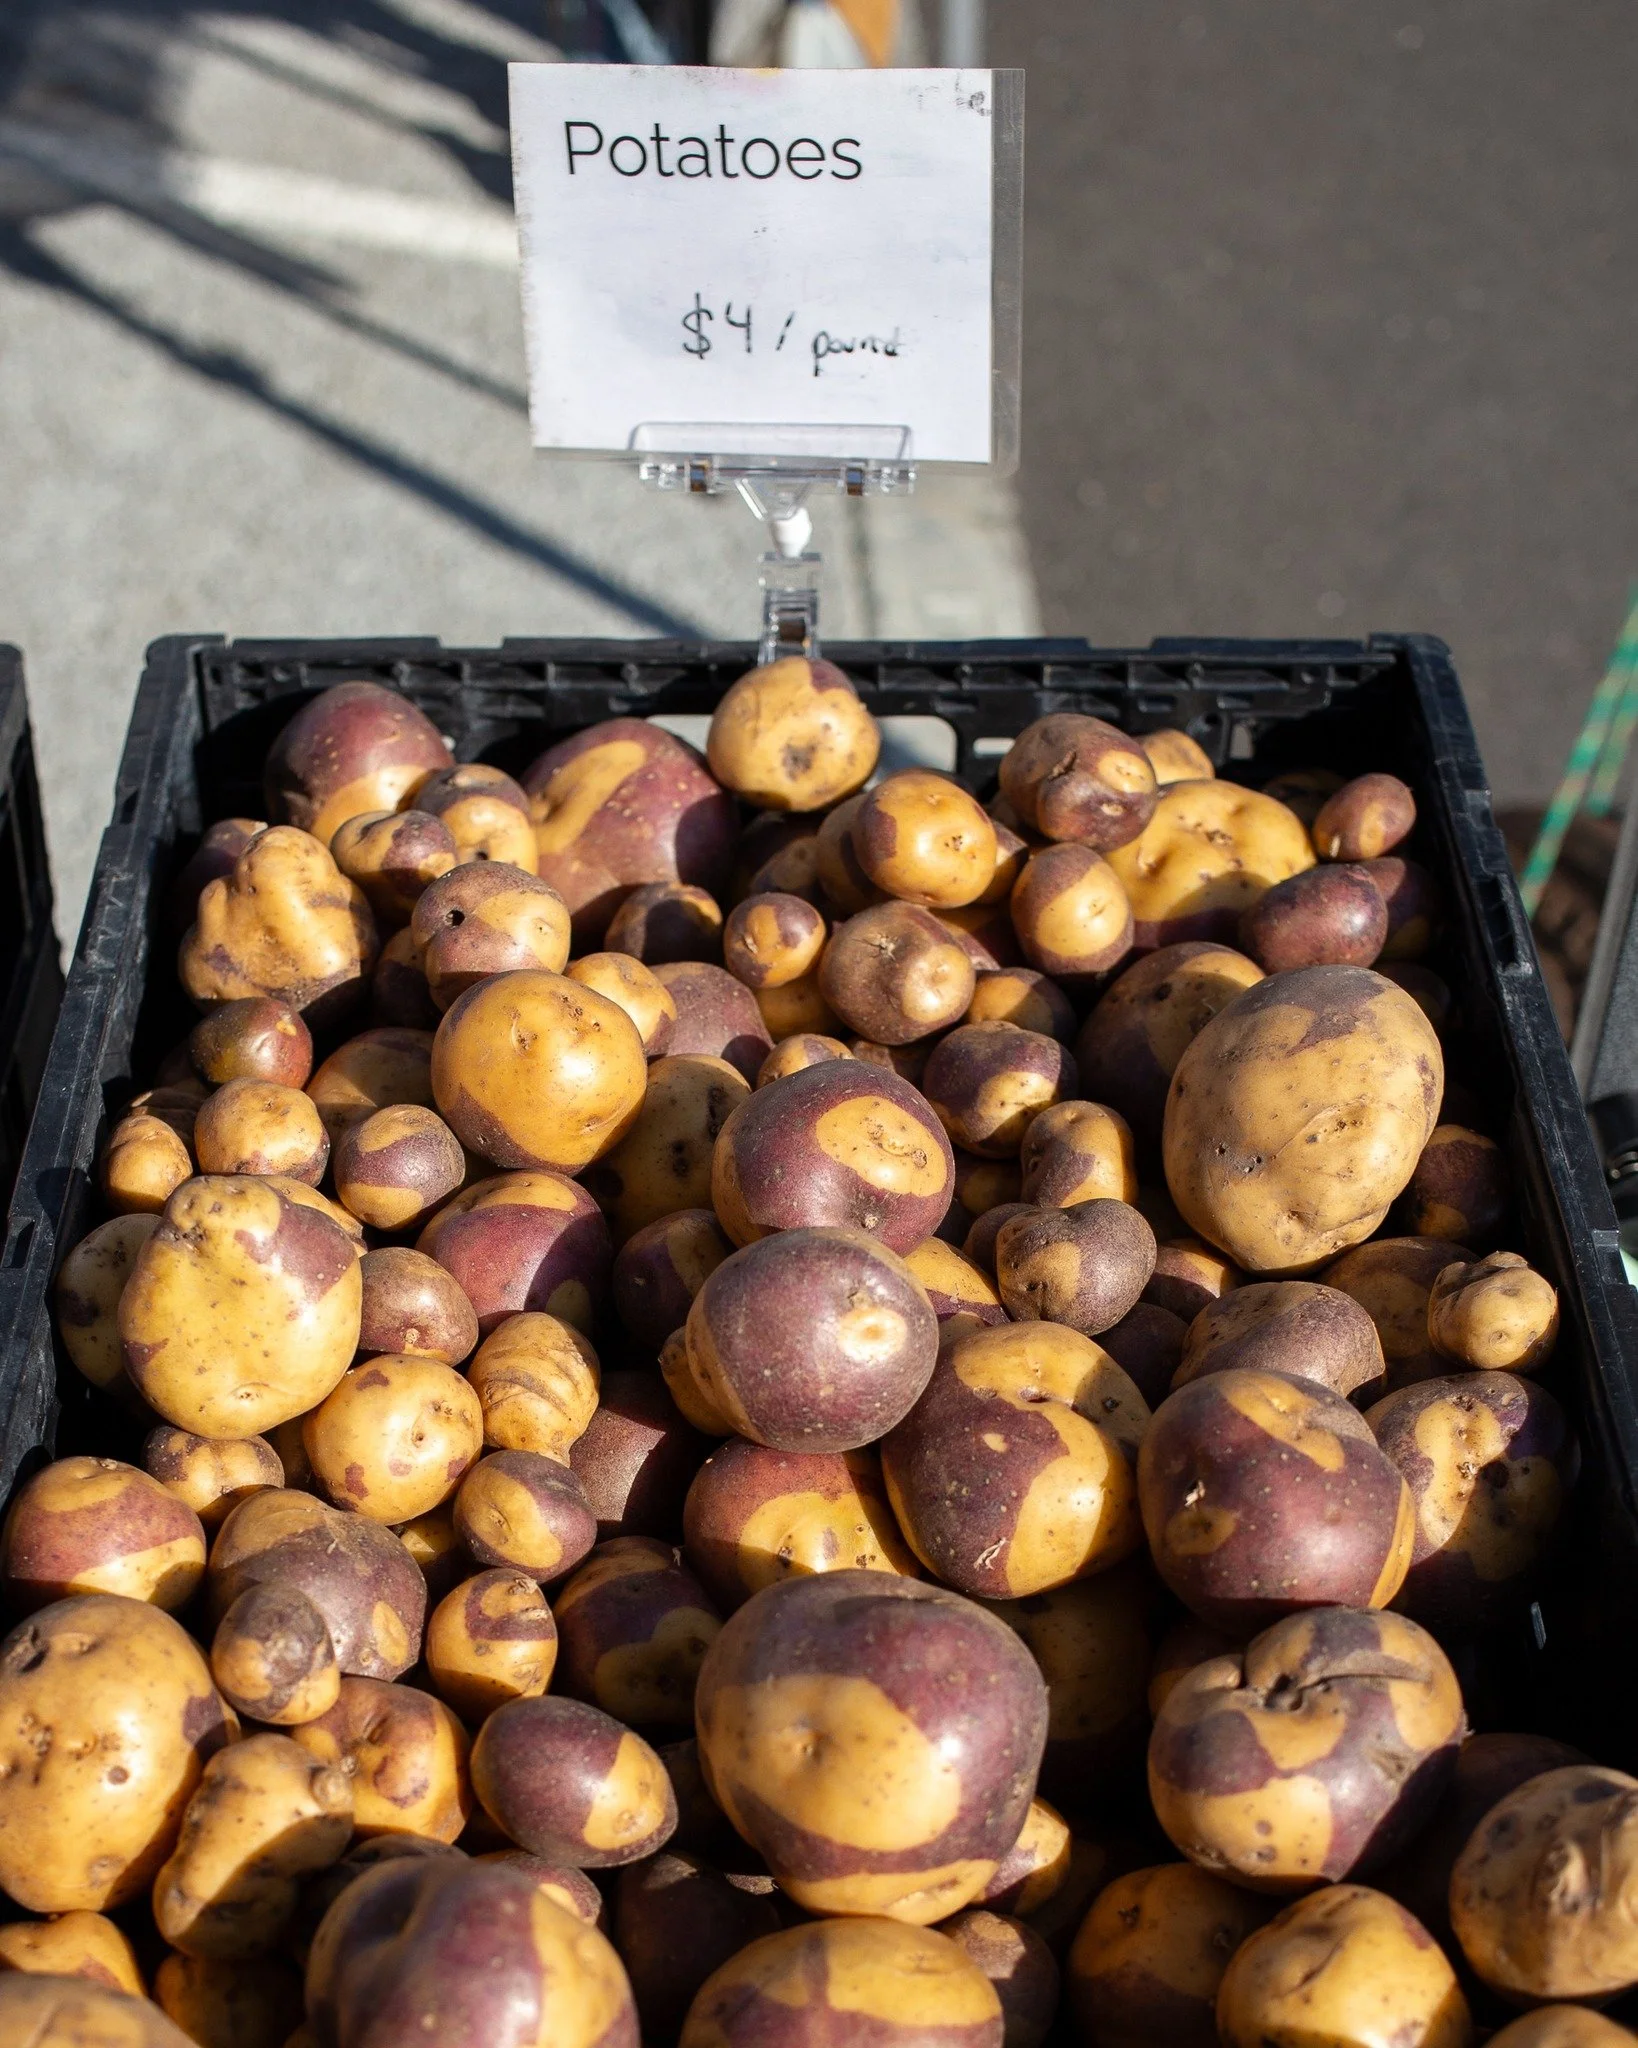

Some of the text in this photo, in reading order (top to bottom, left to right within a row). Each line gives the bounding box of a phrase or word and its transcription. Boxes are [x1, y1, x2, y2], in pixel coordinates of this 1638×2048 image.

[563, 120, 863, 181] Potatoes
[682, 292, 752, 360] $4
[811, 326, 902, 377] pound
